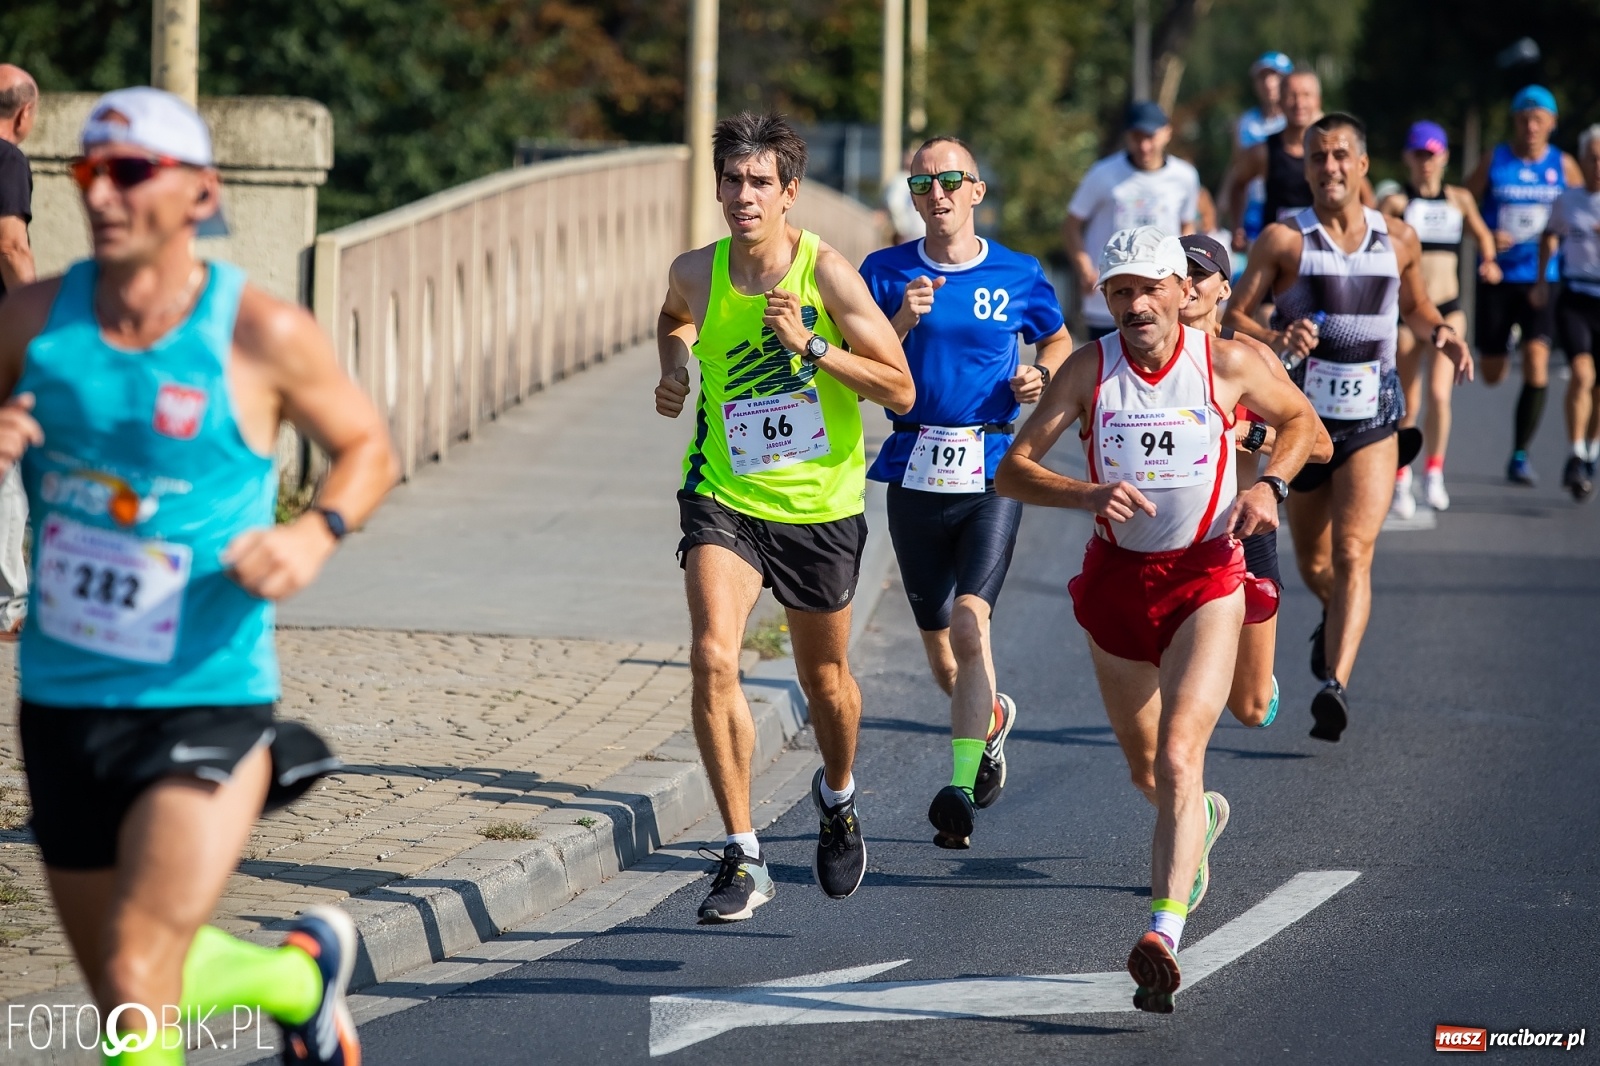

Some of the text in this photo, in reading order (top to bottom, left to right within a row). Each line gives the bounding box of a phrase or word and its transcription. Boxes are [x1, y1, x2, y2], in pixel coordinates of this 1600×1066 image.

[973, 287, 1010, 322] 82
[1329, 378, 1362, 397] 155
[753, 399, 780, 407] RAFAKO
[763, 414, 793, 440] 66
[931, 444, 967, 468] 197
[1140, 430, 1176, 457] 94
[72, 562, 140, 610] 282
